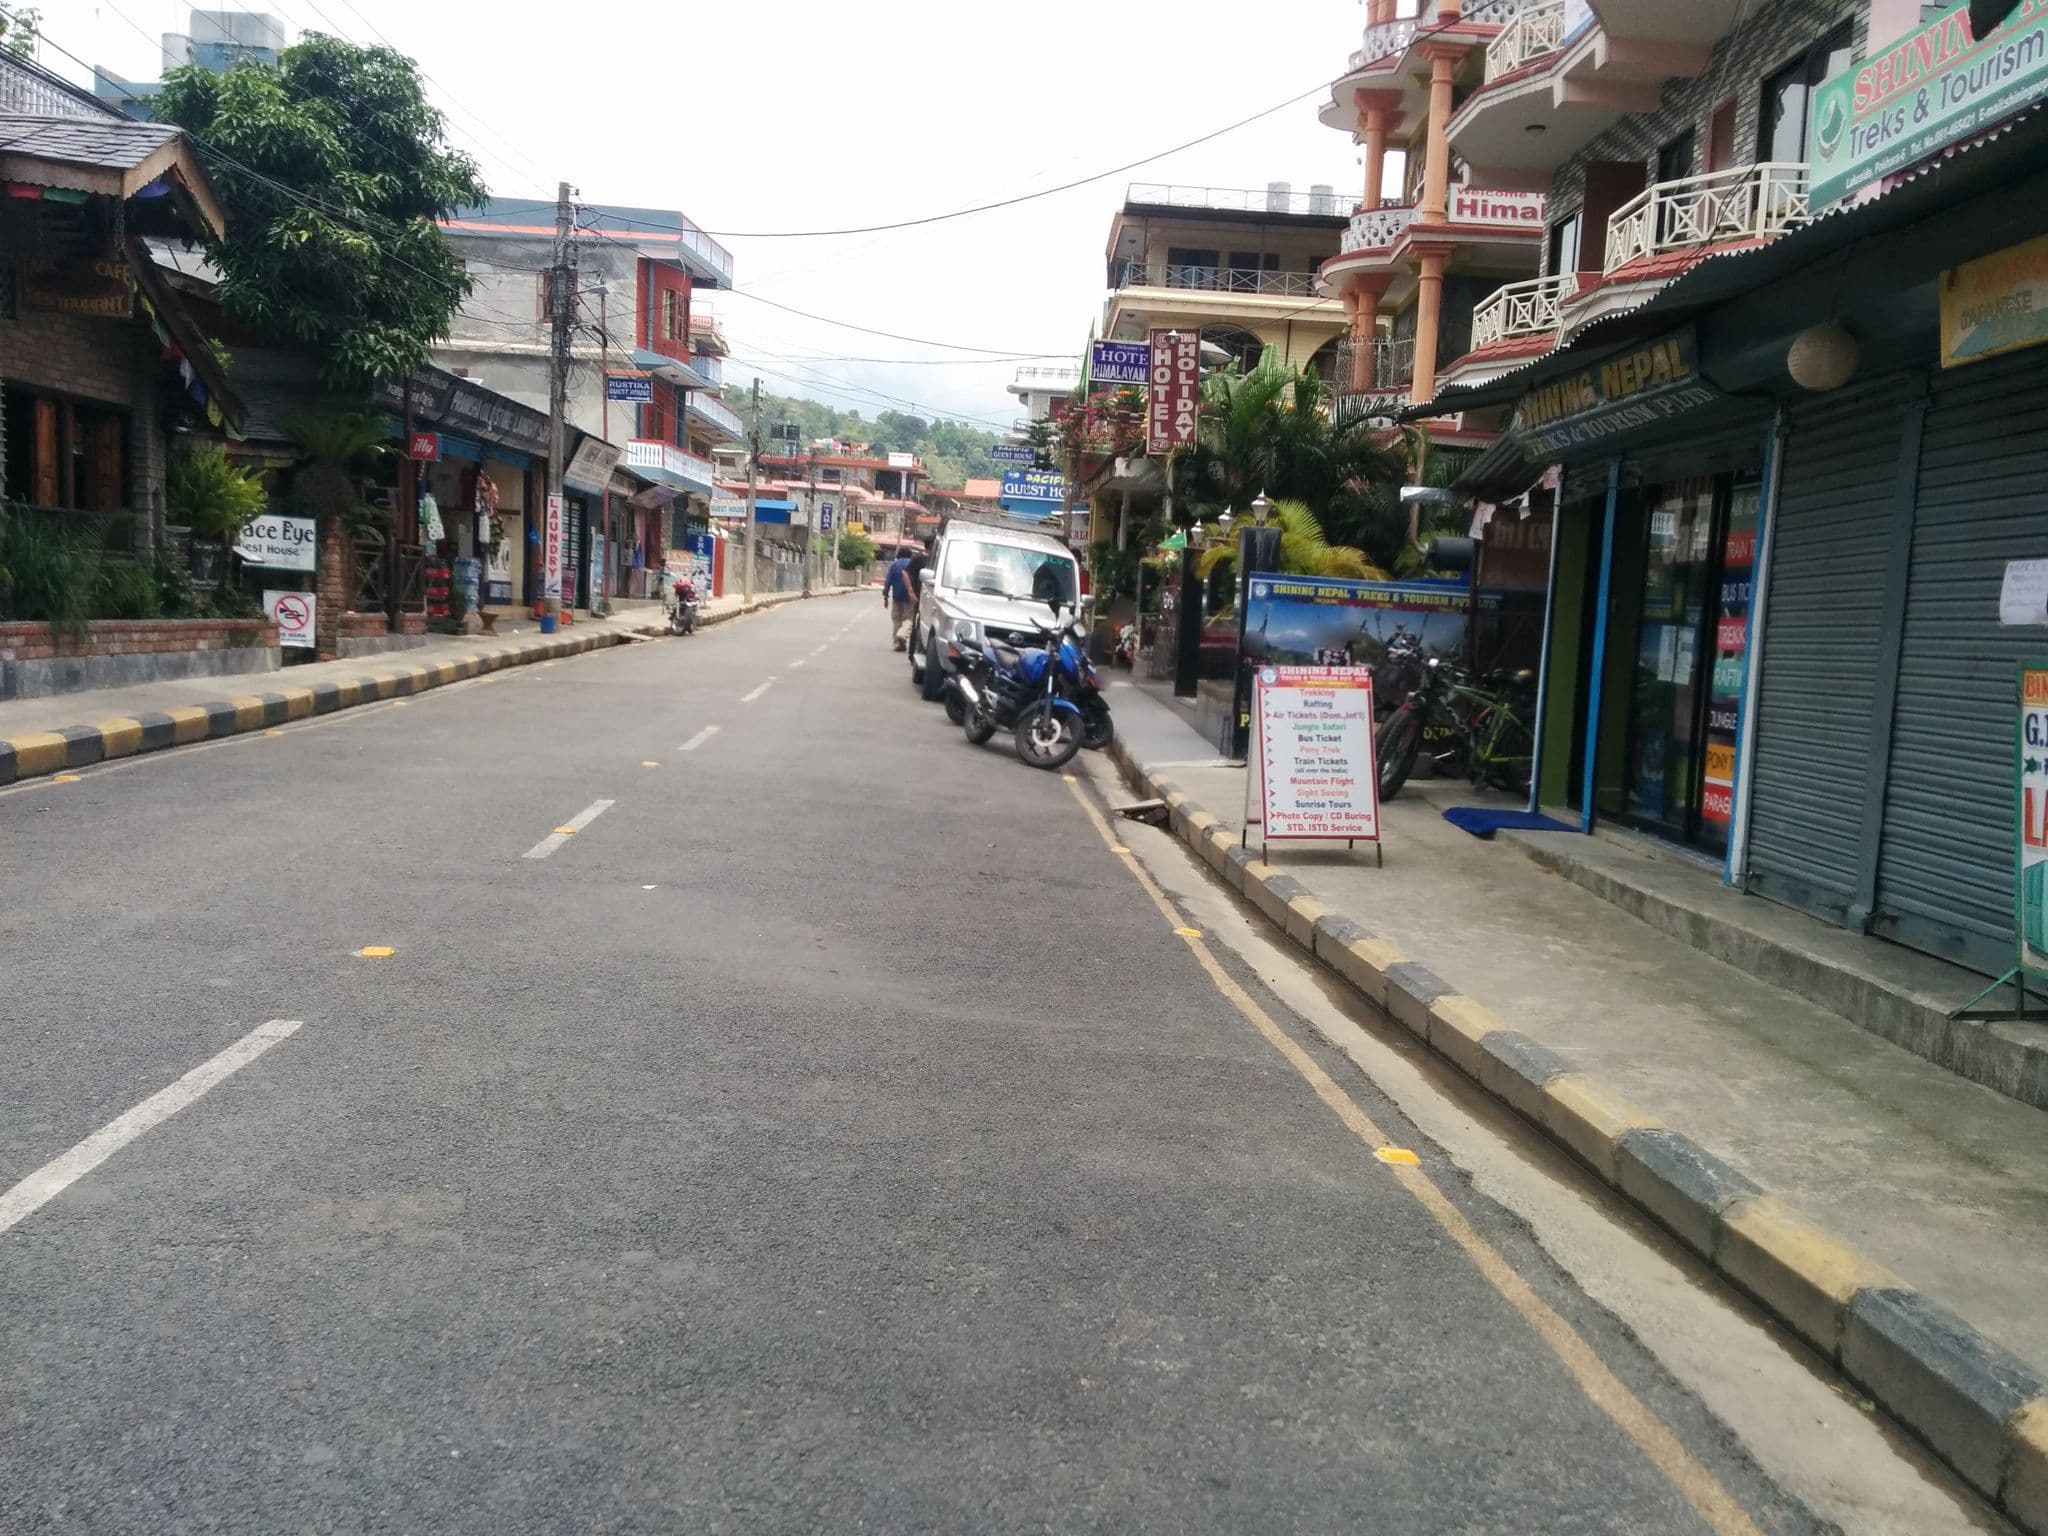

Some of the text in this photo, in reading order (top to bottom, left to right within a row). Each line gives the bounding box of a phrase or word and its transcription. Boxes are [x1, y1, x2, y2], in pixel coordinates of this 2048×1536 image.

[1853, 7, 2003, 112] SHININ
[1850, 28, 2044, 157] Treks & Tourism
[1178, 332, 1197, 344] EWA
[1093, 362, 1145, 382] HIMALAYAN
[1601, 338, 1689, 400] NEPAL
[609, 381, 650, 390] RUSTIKA
[1175, 343, 1196, 439] HOLIDAY
[1154, 349, 1171, 438] HOTEL
[413, 437, 433, 454] illy
[1025, 473, 1073, 486] PACIFI
[1004, 483, 1072, 498] GUEST HO
[243, 520, 314, 545] ace Eye
[549, 498, 558, 577] LAUNDRY
[267, 544, 300, 557] House
[1273, 583, 1315, 596] SHINING
[1317, 586, 1350, 598] NEPAL
[1356, 589, 1390, 601] TREKS
[1403, 593, 1449, 606] TOURISM
[1722, 583, 1736, 602] BUS
[1279, 666, 1369, 676] SHINING NEPAL
[1300, 689, 1336, 698] Trekking
[1304, 700, 1333, 709] Rafting
[1288, 711, 1317, 719] Tickets
[1323, 723, 1346, 731] Safari
[2025, 712, 2048, 747] G.
[1298, 734, 1341, 742] Bus Ticket
[1294, 757, 1348, 766] Train Tickets
[1290, 777, 1354, 787] Mountain Flight
[1297, 788, 1348, 798] Sight Seeing
[1295, 800, 1352, 809] Sunrise Tours
[1276, 812, 1301, 820] Photo
[1303, 812, 1323, 822] Copy
[1330, 812, 1342, 820] CD
[1344, 812, 1371, 822] Buring
[1286, 823, 1362, 832] STD. ISTD Service
